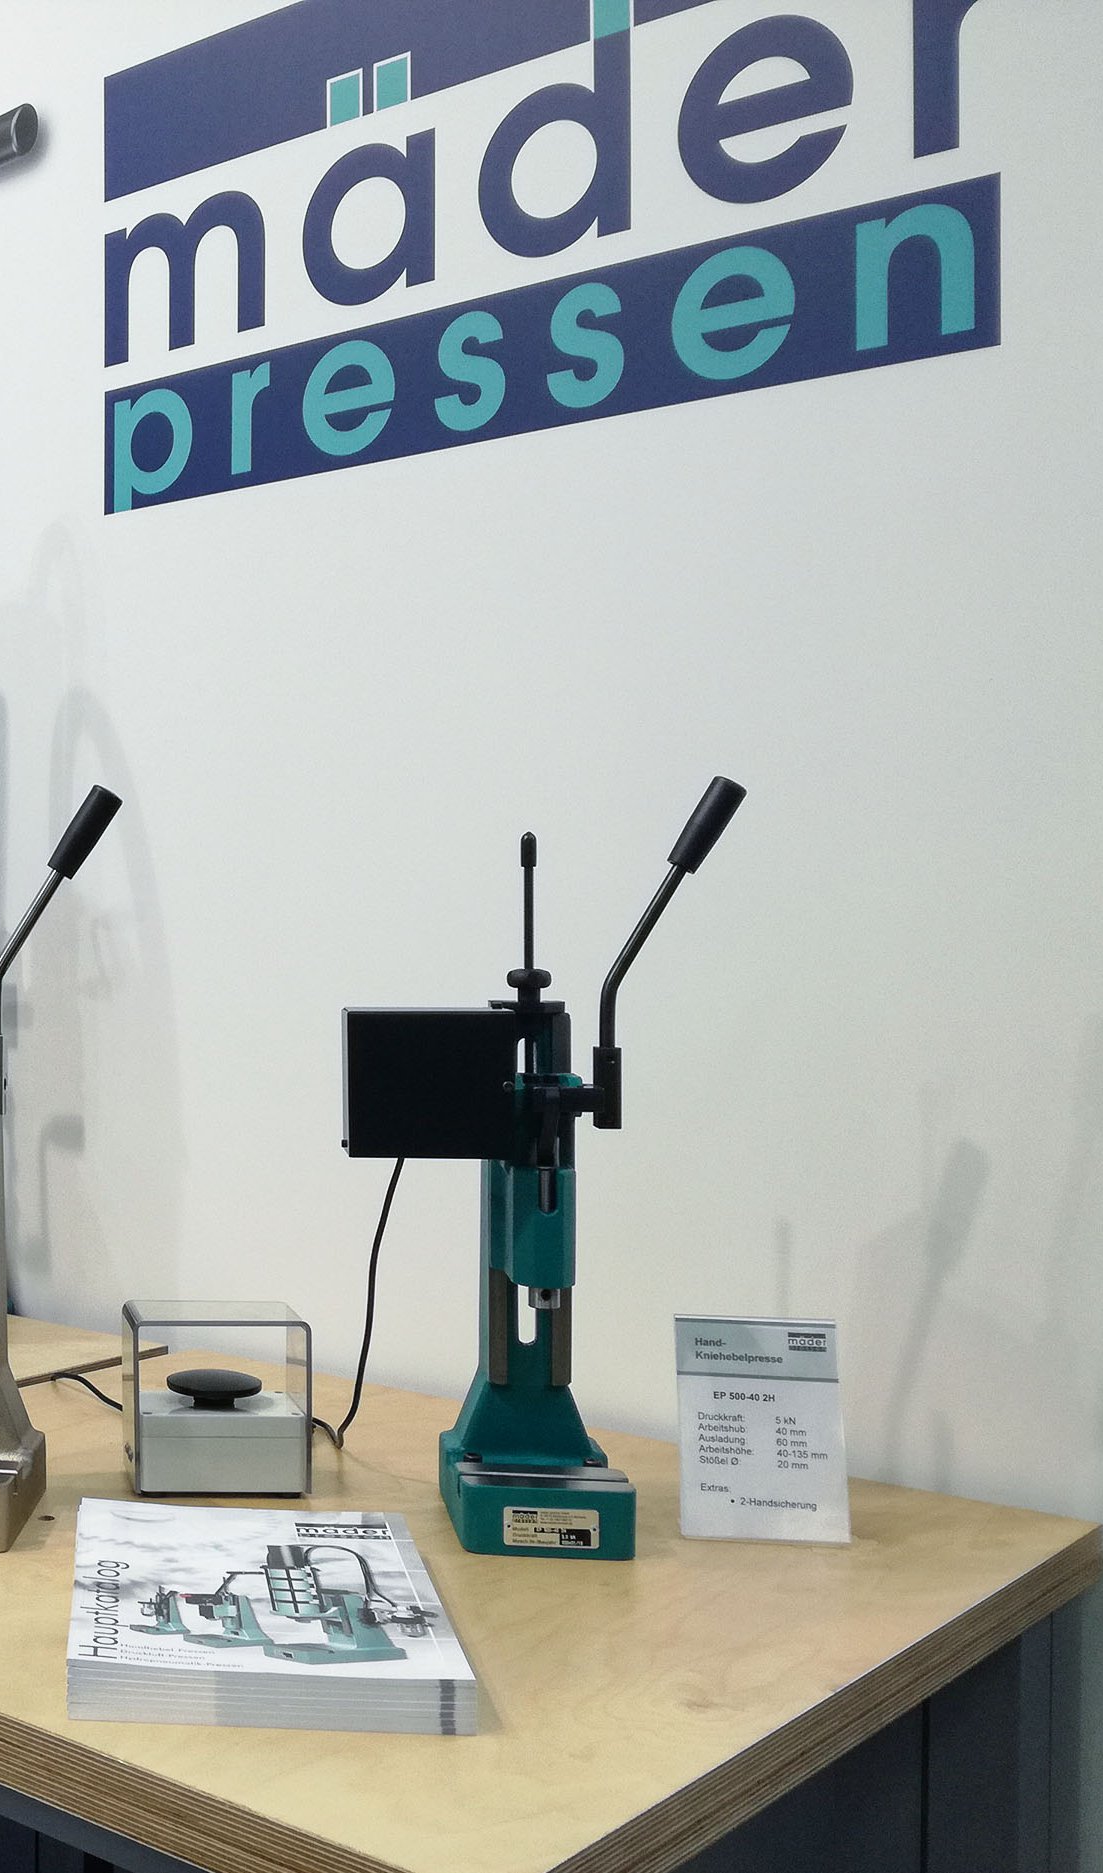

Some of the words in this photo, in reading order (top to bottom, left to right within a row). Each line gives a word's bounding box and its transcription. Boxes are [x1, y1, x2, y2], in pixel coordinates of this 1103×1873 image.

[104, 0, 979, 368] mäder
[113, 202, 976, 513] pressen
[695, 1337, 727, 1347] Hand-
[695, 1350, 784, 1364] Kniehebelpresse
[713, 1391, 727, 1400] EP
[729, 1392, 760, 1402] 500-40
[762, 1393, 775, 1402] 2H
[775, 1416, 782, 1425] 5
[783, 1416, 796, 1425] kN
[775, 1427, 787, 1436] 40
[789, 1429, 807, 1437] mm
[776, 1438, 788, 1447] 60
[790, 1440, 808, 1448] mm
[776, 1449, 809, 1459] 40-135
[811, 1452, 828, 1460] mm
[699, 1455, 728, 1465] Stößel
[777, 1460, 789, 1469] 20
[791, 1462, 809, 1470] mm
[740, 1497, 817, 1512] 2-Handsicherung
[78, 1559, 130, 1659] Hauptkatalog
